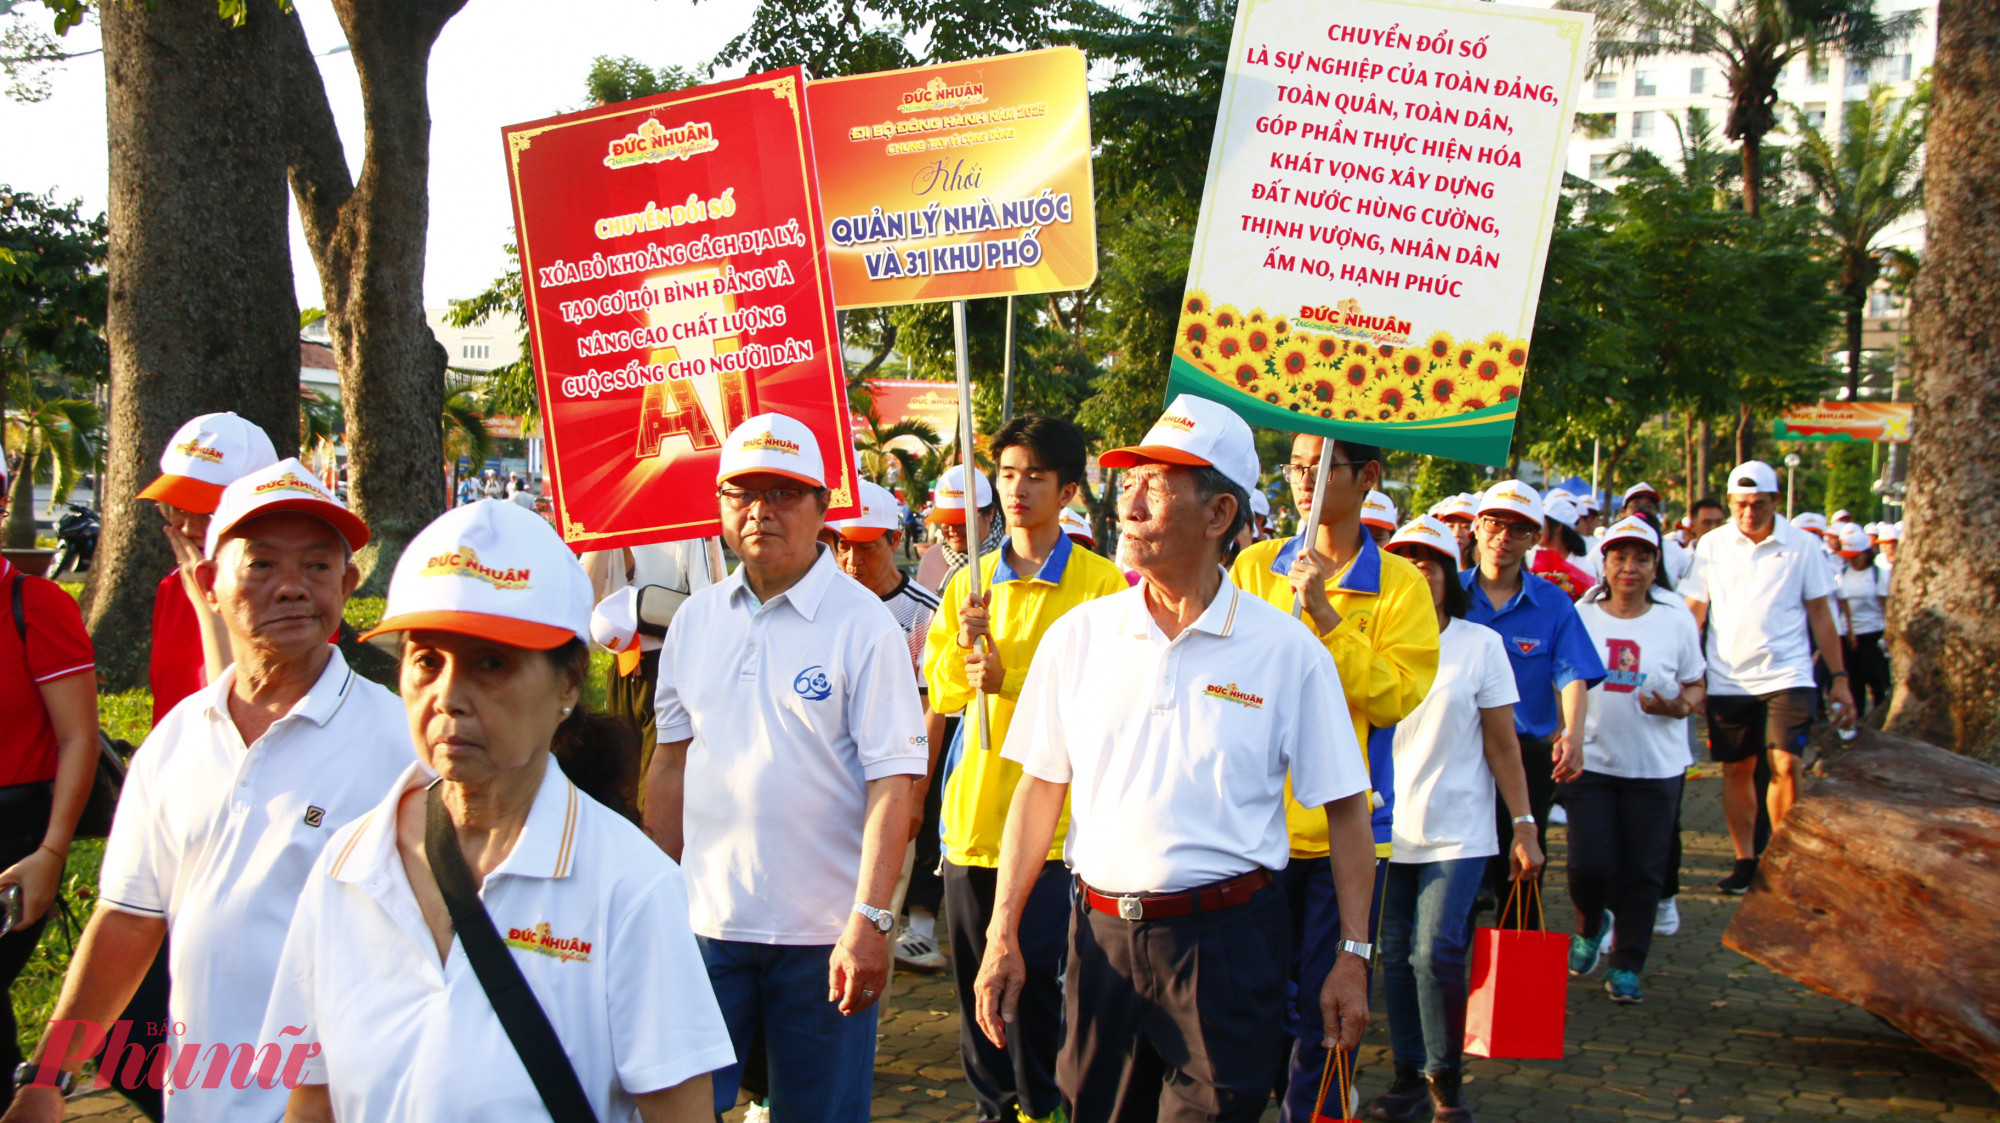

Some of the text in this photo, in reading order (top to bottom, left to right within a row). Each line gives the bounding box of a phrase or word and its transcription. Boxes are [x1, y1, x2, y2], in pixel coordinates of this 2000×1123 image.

[1327, 22, 1490, 59] CHUYỂN ĐỔI SỐ
[904, 89, 931, 104] ĐỨC
[936, 83, 983, 101] NHUẬN
[1246, 44, 1557, 103] LÀ SỰ NGHIỆP CỦA TOÀN ĐẢNG,
[850, 127, 869, 140] ĐI
[872, 122, 894, 139] BỘ
[1017, 103, 1046, 119] 2025
[1277, 83, 1513, 136] TOÀN QUÂN, TOÀN DÂN,
[612, 126, 709, 156] ĐỨC NHUẬN
[887, 140, 925, 154] CHUNG
[927, 137, 948, 149] TAY
[1255, 113, 1522, 169] GÓP PHẦN THỰC HIỆN HÓA
[912, 157, 983, 195] Khối
[1270, 151, 1495, 199] KHÁT VỌNG XÂY DỰNG
[596, 188, 736, 238] CHUYỂN ĐỔI SỐ
[831, 190, 1070, 244] QUẢN LÝ NHÀ NƯỚC
[1251, 178, 1500, 238] ĐẤT NƯỚC HÙNG CƯỜNG,
[540, 220, 806, 288] XÓA BỎ KHOẢNG CÁCH ĐỊA LÝ,
[866, 230, 1040, 277] VÀ 31 KHU PHỐ
[1241, 214, 1500, 269] THỊNH VƯỢNG, NHÂN DÂN
[560, 297, 598, 323] TẠO
[599, 291, 625, 317] CƠ
[626, 284, 660, 308] HỘI
[664, 280, 709, 303] BÌNH
[765, 261, 794, 287] VÀ
[1263, 245, 1463, 298] ẤM NO, HẠNH PHÚC
[578, 306, 786, 356] NÂNG CAO CHẤT LƯỢNG
[1300, 305, 1411, 335] ĐỨC NHUẬN
[562, 341, 813, 398] CUỘC SỐNG CHO NGƯỜI DÂN
[427, 552, 461, 568] ĐỨC
[465, 559, 530, 584] NHUẬN
[508, 928, 537, 943] ĐỨC
